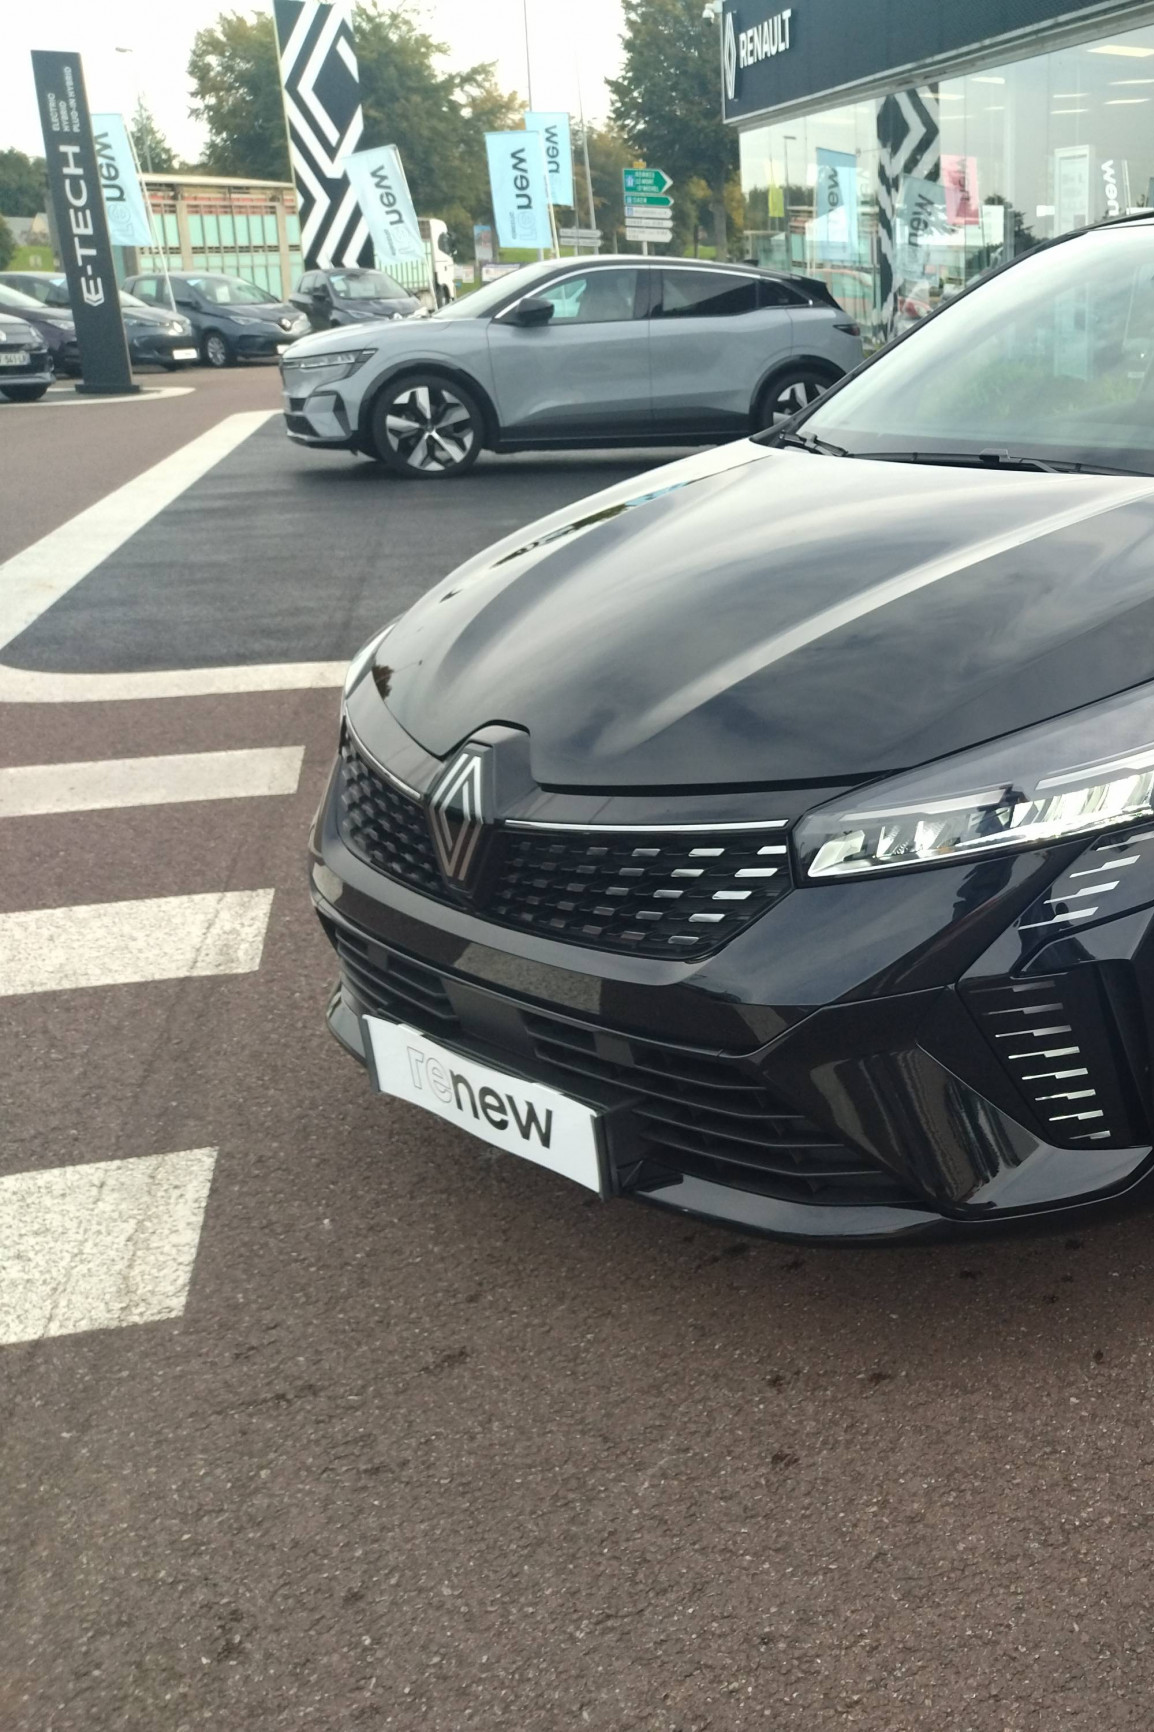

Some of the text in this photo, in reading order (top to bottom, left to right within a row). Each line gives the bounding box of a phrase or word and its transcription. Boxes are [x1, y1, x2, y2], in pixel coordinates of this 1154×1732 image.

[739, 8, 792, 69] RENAULT
[58, 144, 105, 307] E-TECH
[406, 1046, 553, 1149] renew
